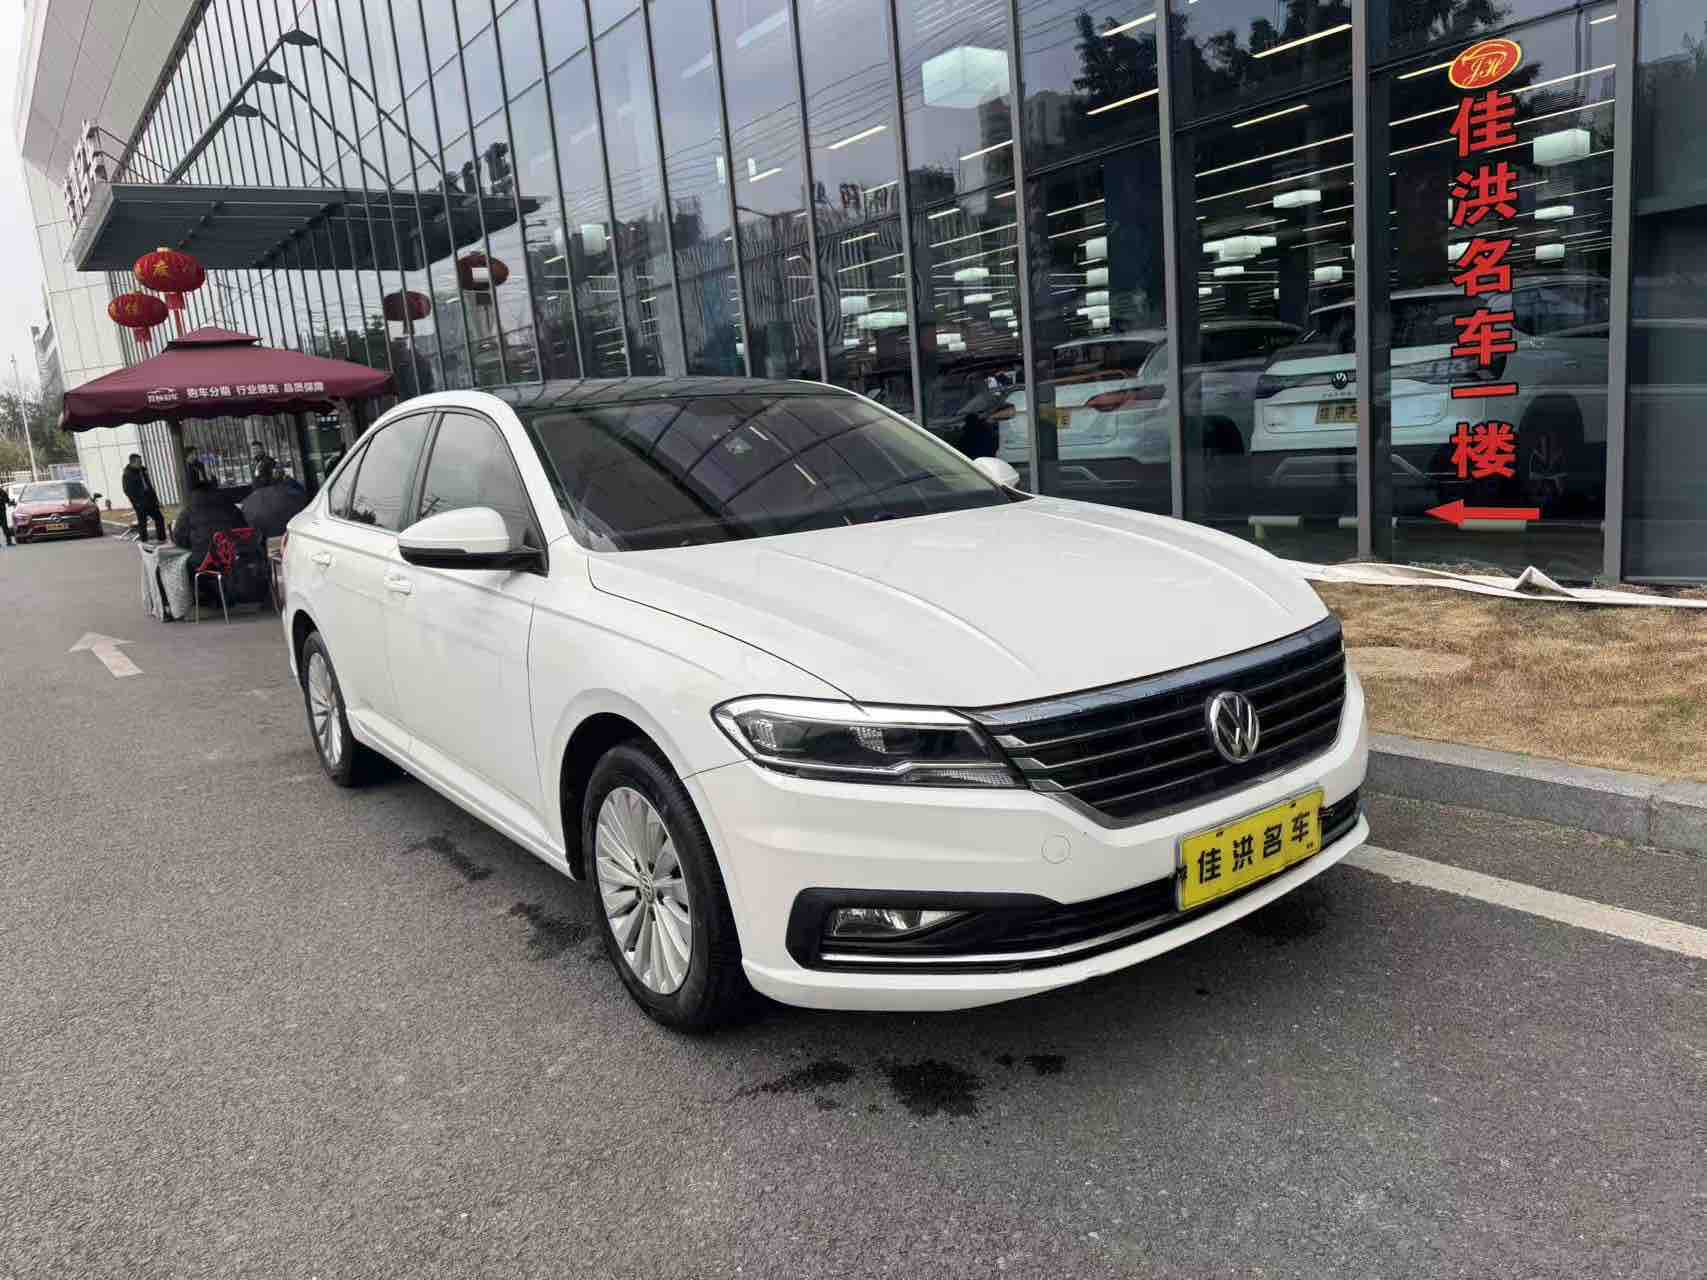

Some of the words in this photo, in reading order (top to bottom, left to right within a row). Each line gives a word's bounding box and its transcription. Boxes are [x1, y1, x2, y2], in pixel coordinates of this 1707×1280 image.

[1450, 88, 1519, 480] 佳洪名车一楼
[1197, 811, 1311, 885] 佳洪名车
